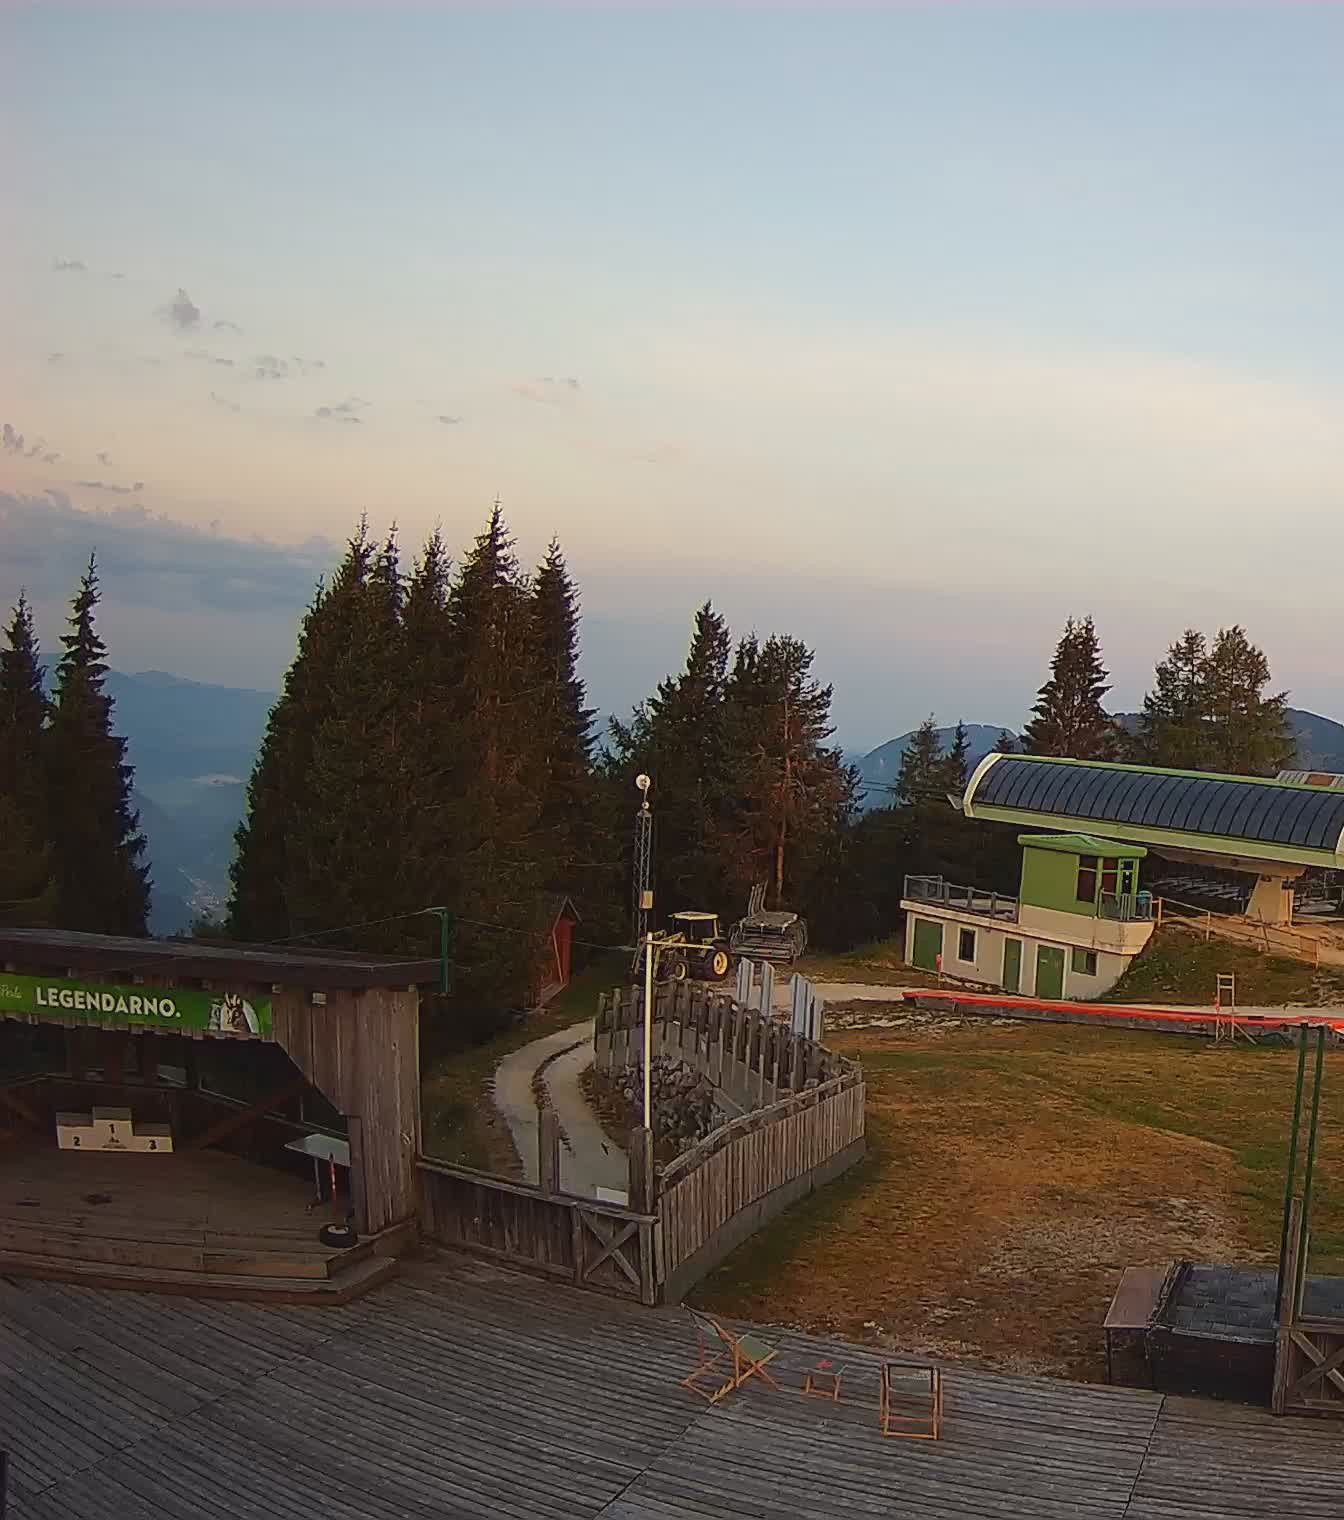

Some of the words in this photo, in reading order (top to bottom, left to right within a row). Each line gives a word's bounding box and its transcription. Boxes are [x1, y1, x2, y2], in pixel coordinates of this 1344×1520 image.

[35, 987, 182, 1018] LEGENDARNO.
[108, 1123, 115, 1134] 1
[72, 1136, 81, 1146] 2
[148, 1139, 157, 1150] 3
